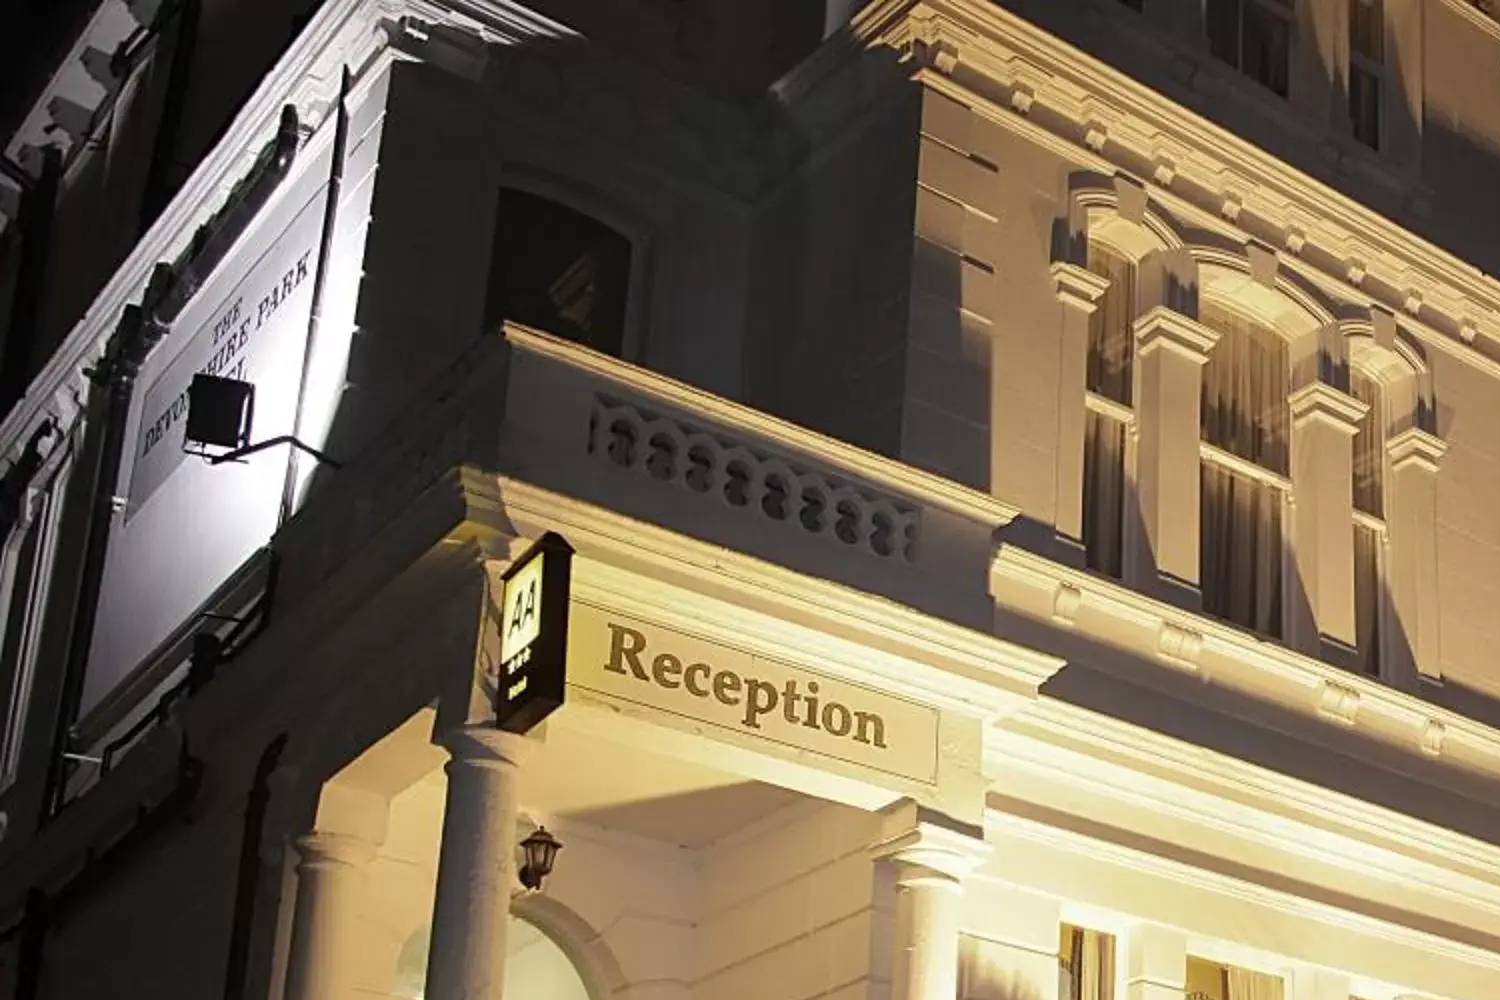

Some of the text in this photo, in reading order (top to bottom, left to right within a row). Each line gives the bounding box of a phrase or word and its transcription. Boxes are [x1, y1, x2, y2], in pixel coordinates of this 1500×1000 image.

[142, 249, 311, 457] DEVOHIRE PARK
[211, 296, 242, 348] THE
[508, 578, 537, 641] AA
[603, 621, 888, 750] Reception
